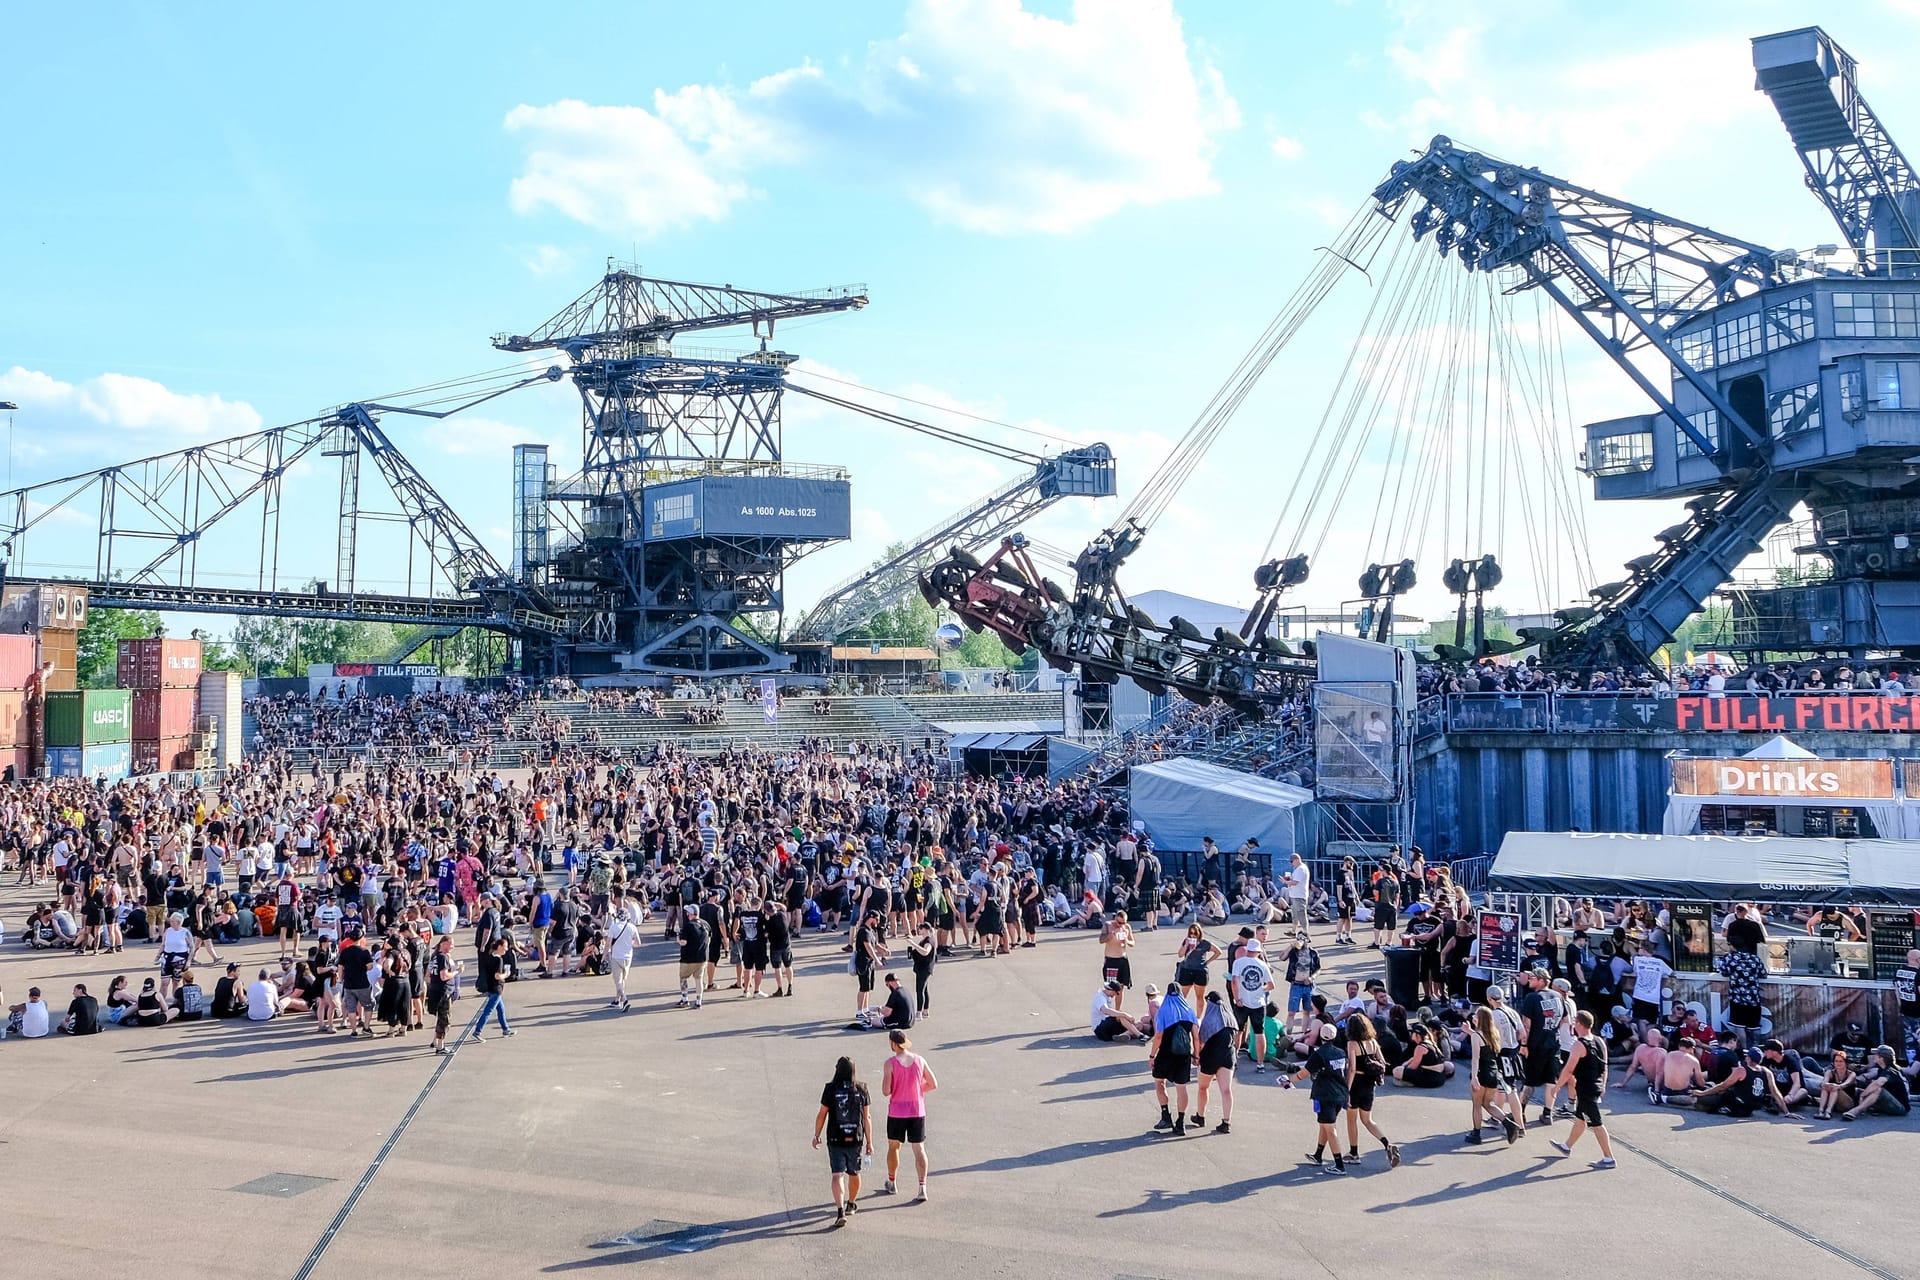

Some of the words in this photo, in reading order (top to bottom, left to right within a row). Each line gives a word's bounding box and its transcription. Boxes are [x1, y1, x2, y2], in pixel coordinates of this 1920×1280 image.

[741, 506, 753, 515] As
[756, 507, 774, 516] 1600
[378, 666, 403, 676] FULL
[405, 666, 438, 676] FORCE
[93, 709, 123, 724] UASC
[1676, 697, 1786, 730] FULL
[1720, 764, 1840, 792] Drinks
